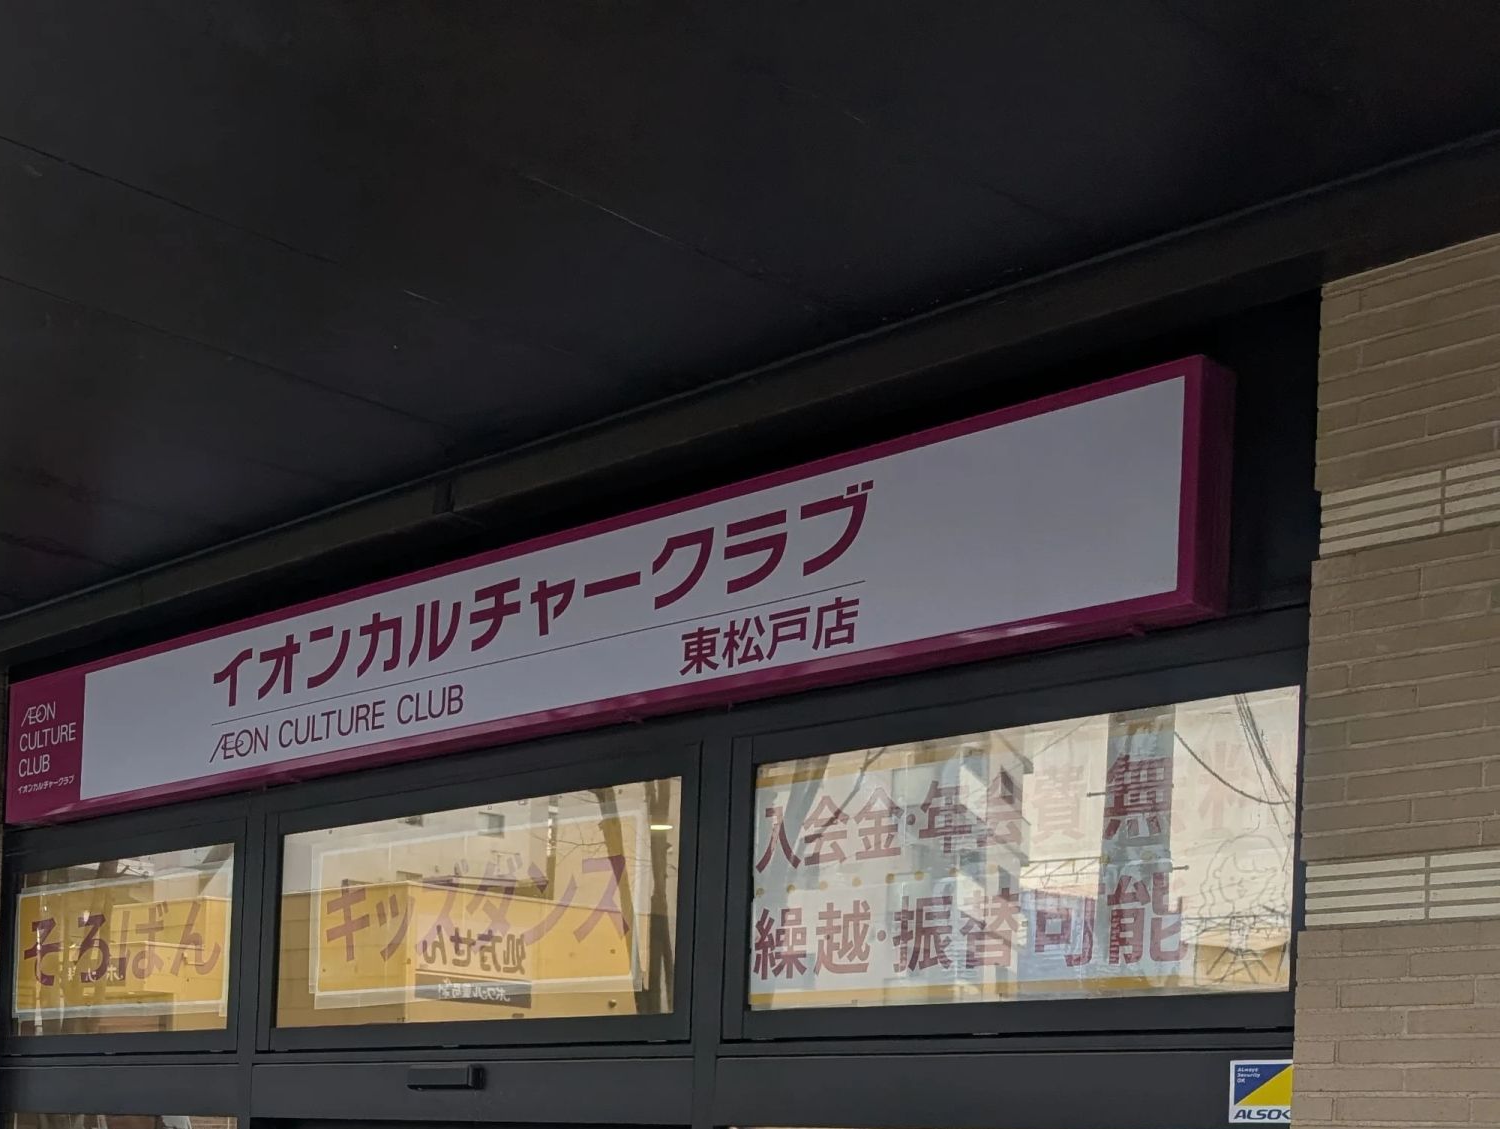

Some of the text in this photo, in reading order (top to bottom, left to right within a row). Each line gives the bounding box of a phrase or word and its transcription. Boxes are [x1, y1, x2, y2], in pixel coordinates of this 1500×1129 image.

[212, 482, 873, 707] イオンカルチャークラブ
[680, 600, 861, 677] 東松戸店
[19, 722, 77, 752] CULTURE
[278, 701, 386, 749] CULTURE
[397, 684, 464, 725] CLUB
[18, 754, 50, 778] CLUB
[18, 775, 75, 795] イオンカルチャークラブ
[23, 900, 222, 987] そろばん
[325, 853, 630, 962] キッズダンス
[754, 871, 1189, 981] 繰越・振替可能
